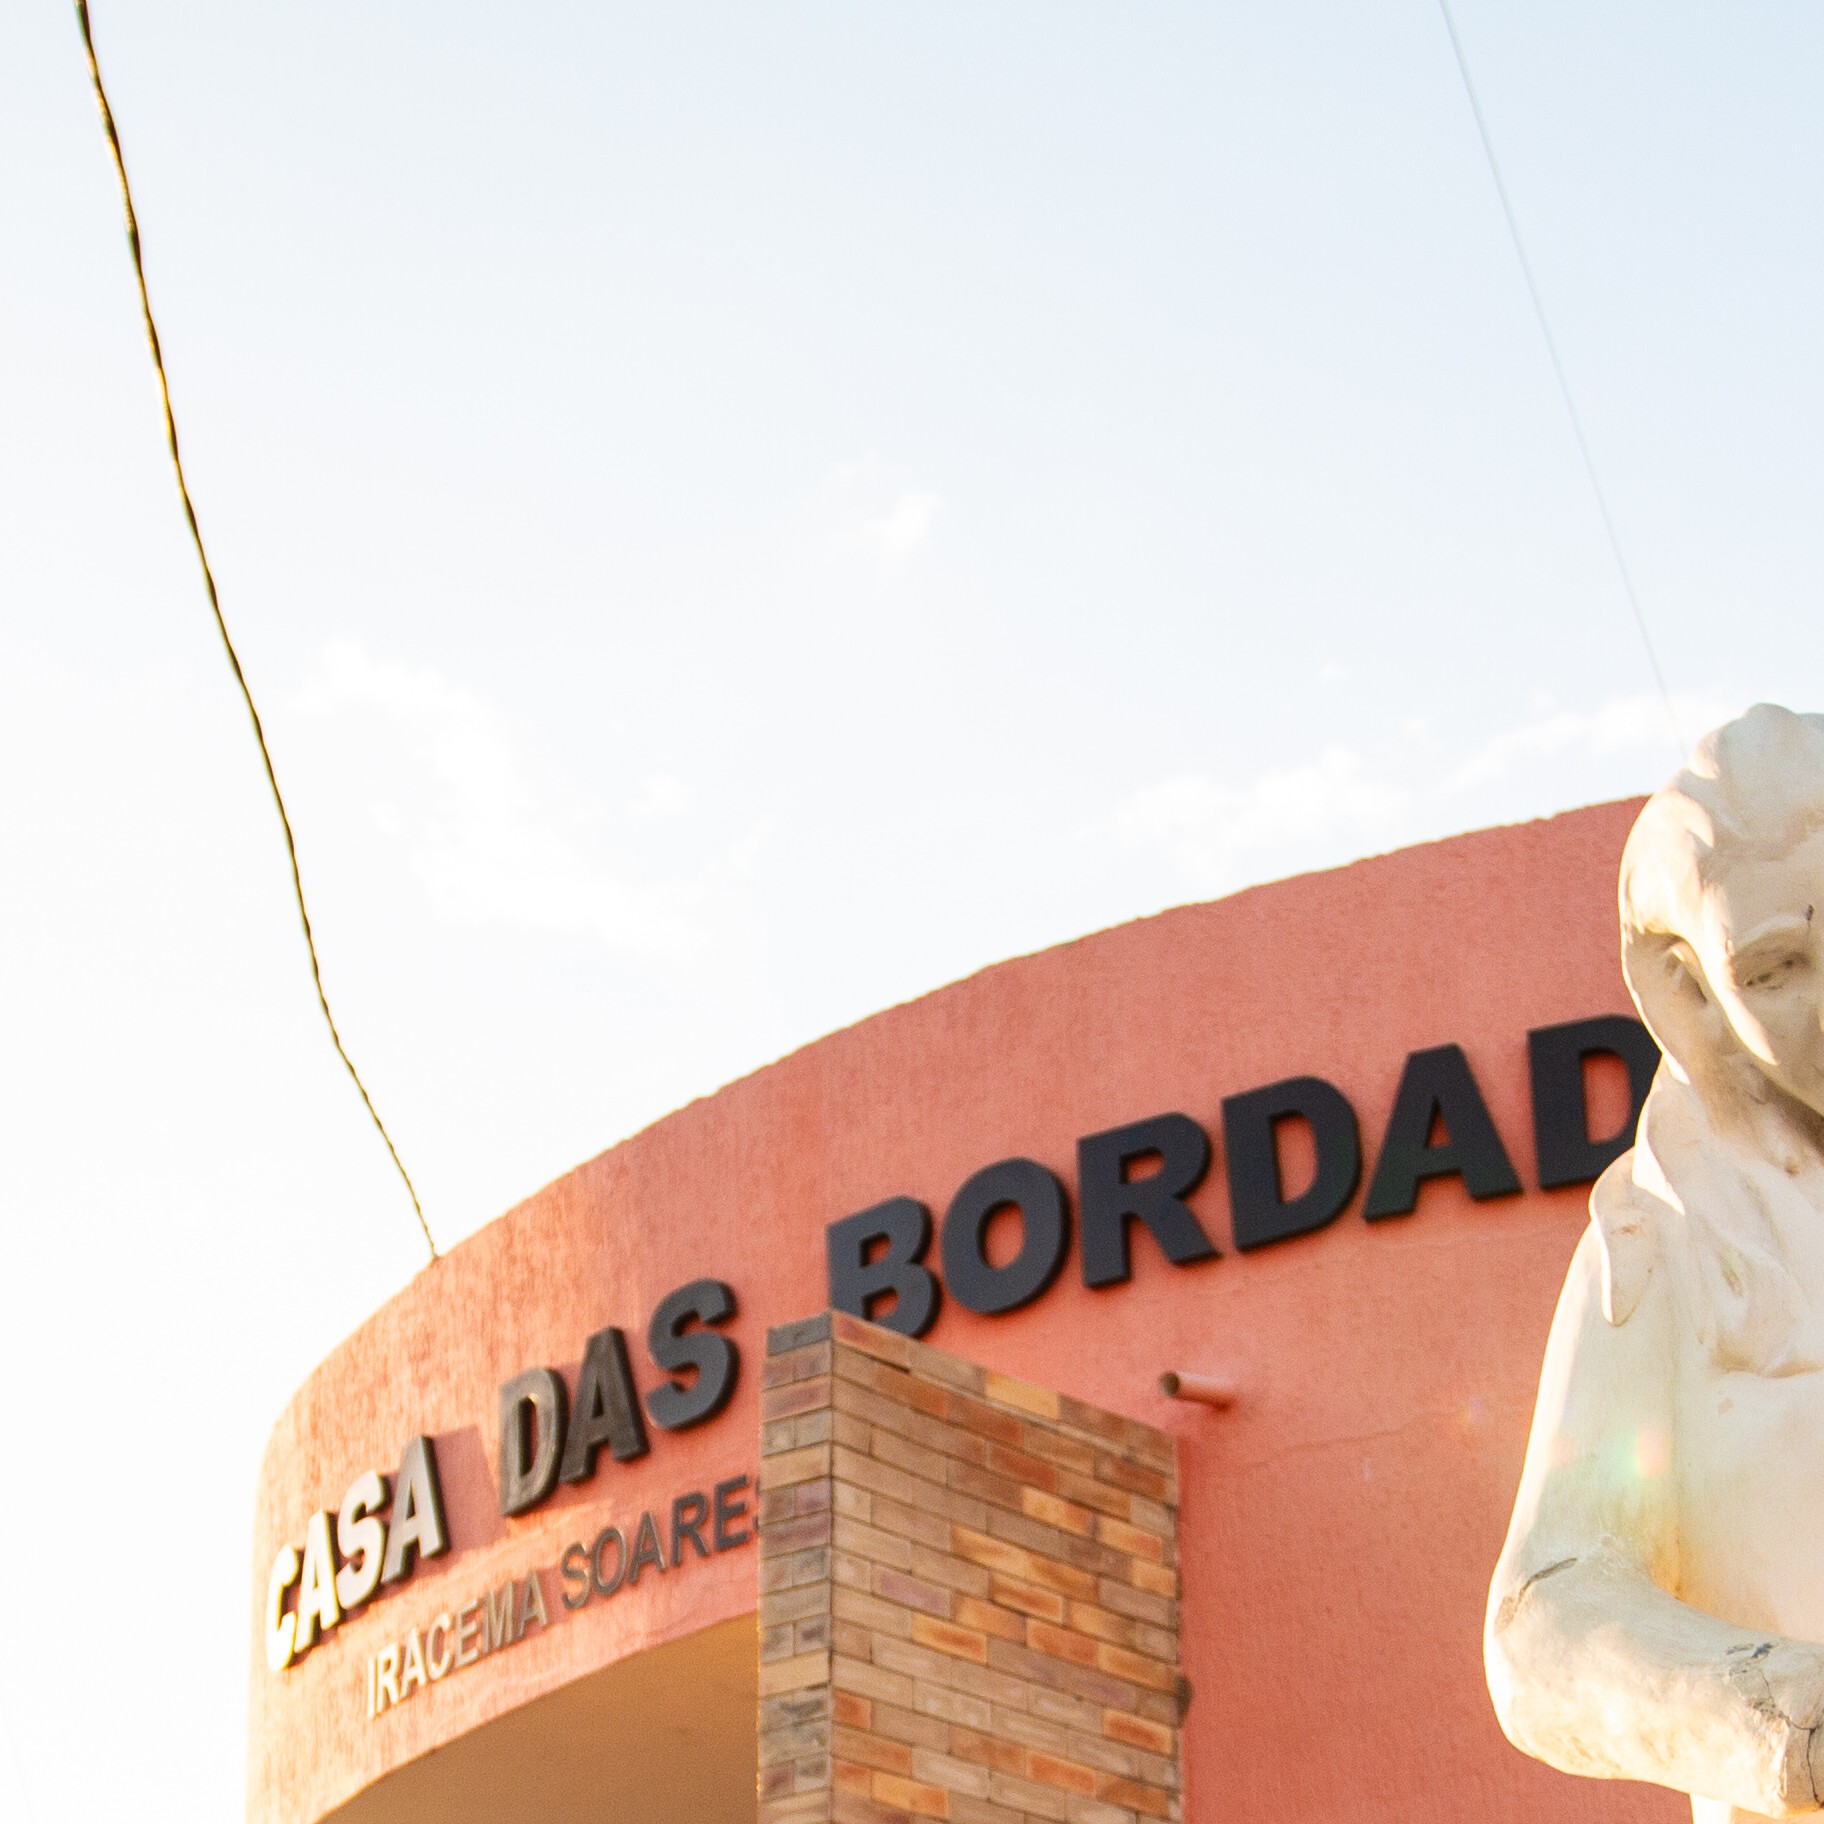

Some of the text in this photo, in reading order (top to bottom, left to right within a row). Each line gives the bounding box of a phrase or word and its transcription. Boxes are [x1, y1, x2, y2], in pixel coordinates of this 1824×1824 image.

[264, 1433, 452, 1674] CASA
[498, 1277, 741, 1519] DAS
[365, 1472, 761, 1721] IRACEMA SOARE
